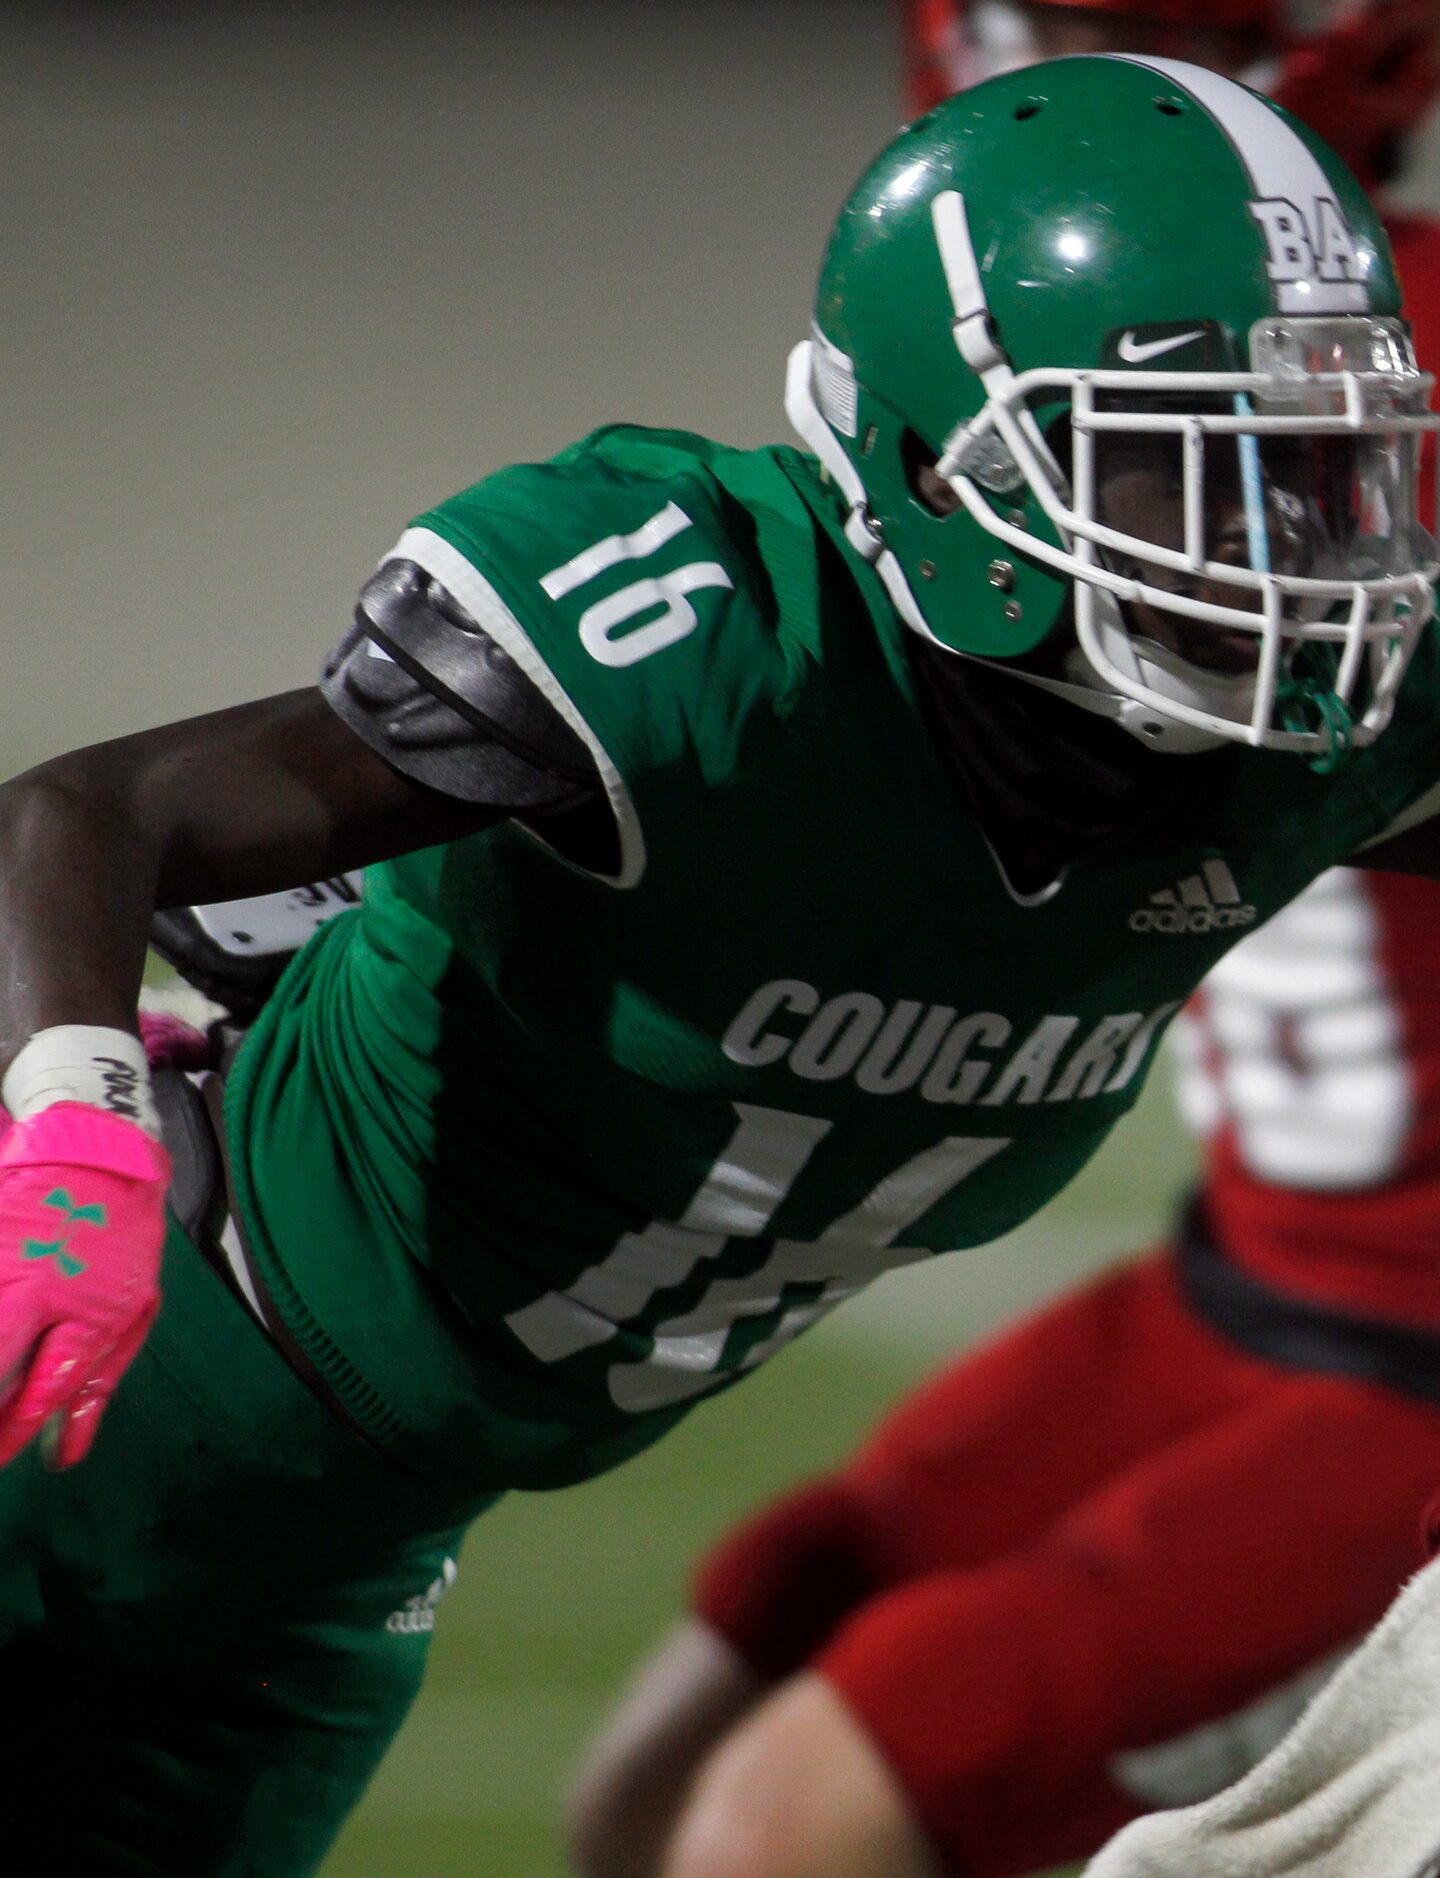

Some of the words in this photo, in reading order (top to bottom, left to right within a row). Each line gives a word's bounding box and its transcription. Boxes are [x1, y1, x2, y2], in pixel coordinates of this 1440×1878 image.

[1248, 197, 1369, 283] BA
[538, 500, 735, 668] 16
[1129, 901, 1256, 933] adidas
[504, 1101, 1012, 1413] 16
